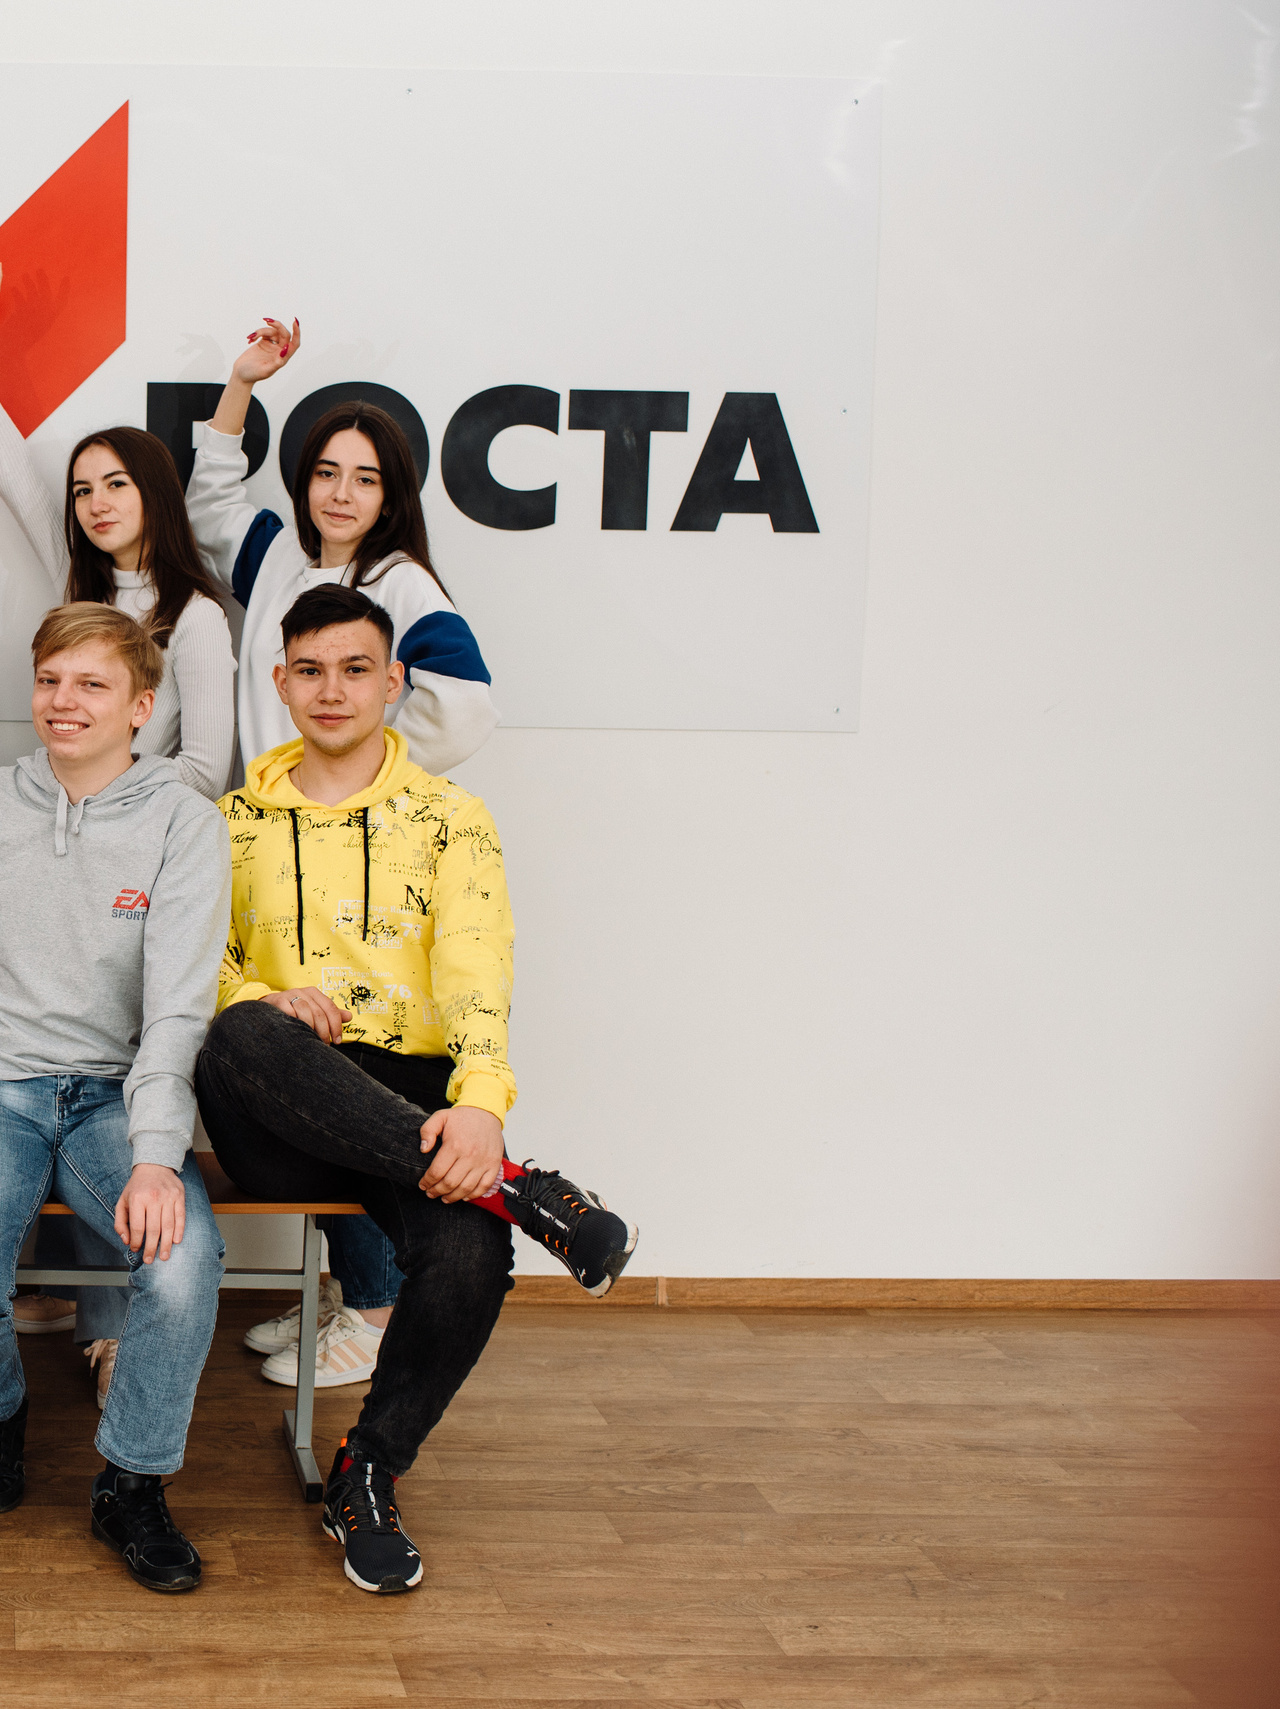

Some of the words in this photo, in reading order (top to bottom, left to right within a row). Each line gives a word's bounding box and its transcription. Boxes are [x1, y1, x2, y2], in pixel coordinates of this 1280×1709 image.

[146, 381, 820, 534] РОСТА
[111, 888, 150, 911] EA
[382, 984, 414, 999] 76
